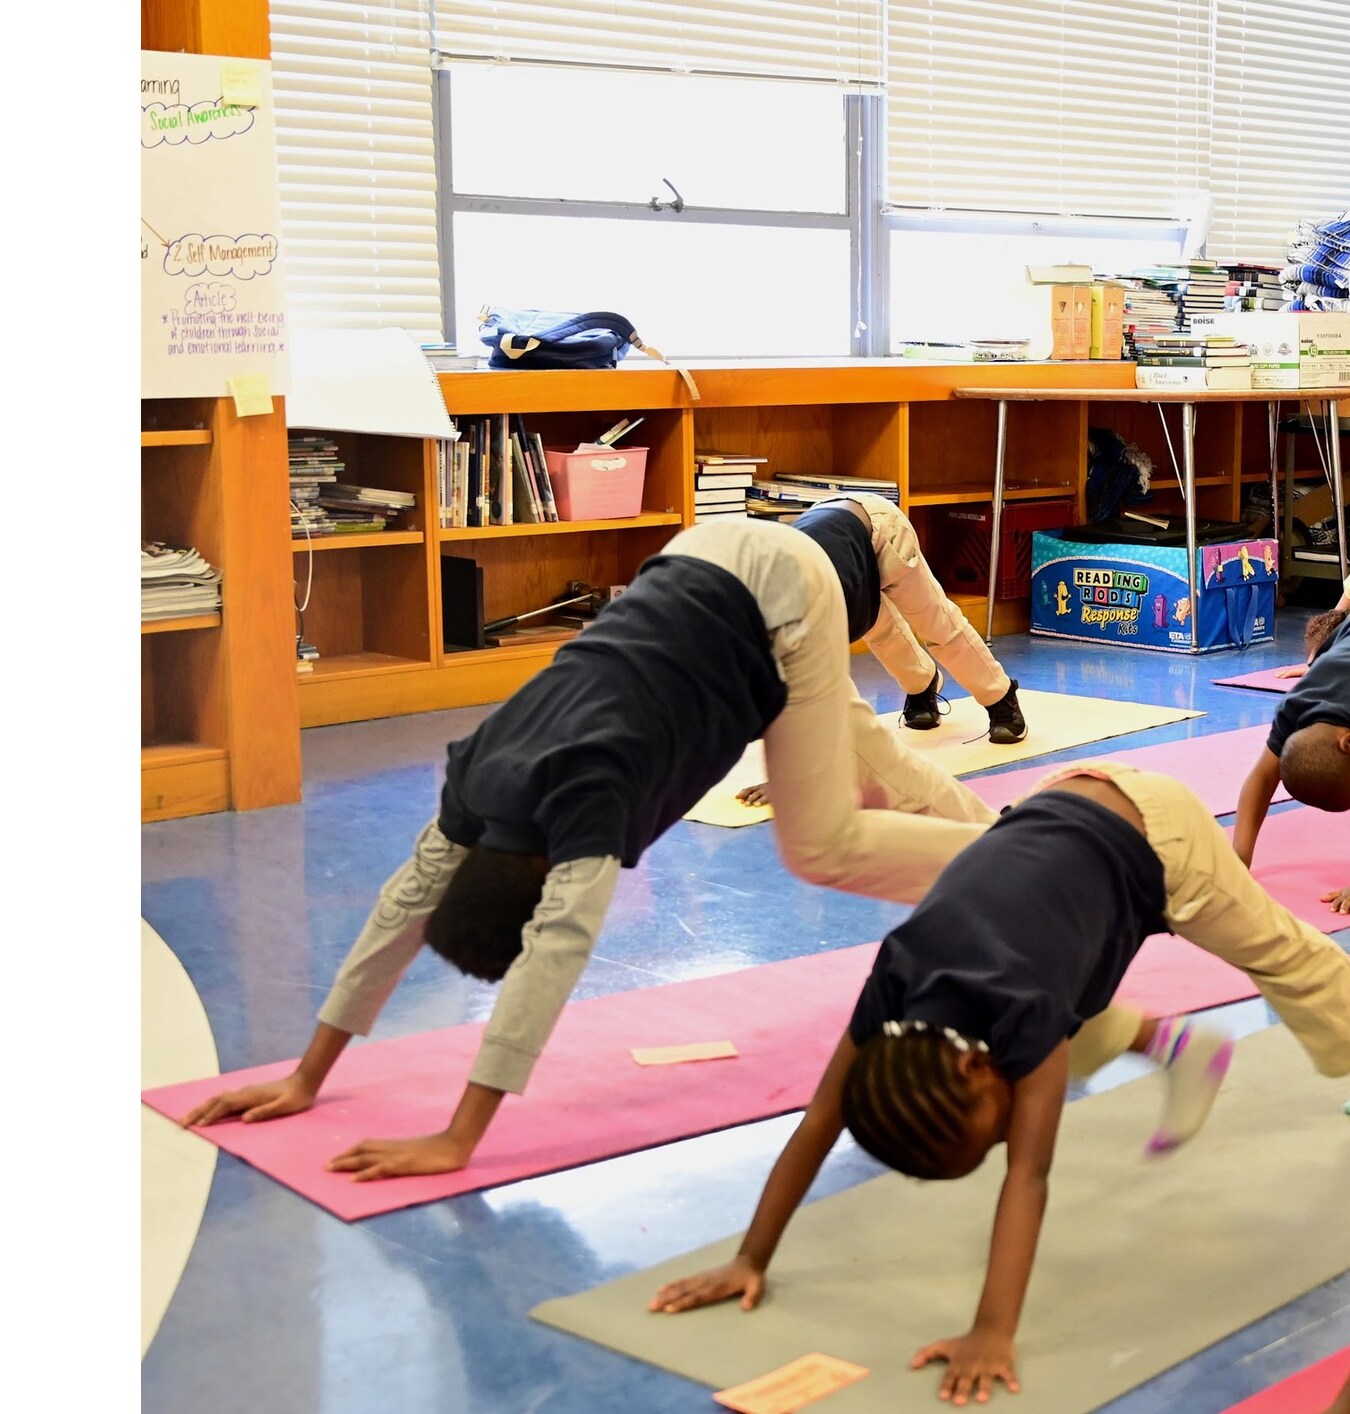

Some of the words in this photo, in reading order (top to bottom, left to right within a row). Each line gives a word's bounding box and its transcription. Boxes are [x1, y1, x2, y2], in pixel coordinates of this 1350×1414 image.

[150, 110, 182, 131] Social
[187, 242, 205, 264] Self
[209, 241, 272, 265] Management
[193, 290, 227, 308] Article
[220, 312, 233, 323] the
[181, 326, 215, 340] children
[168, 343, 184, 355] and
[187, 341, 231, 354] emotional
[235, 342, 276, 358] learning
[1083, 587, 1132, 604] RODS
[1081, 606, 1138, 630] Response
[1117, 622, 1138, 635] Kits
